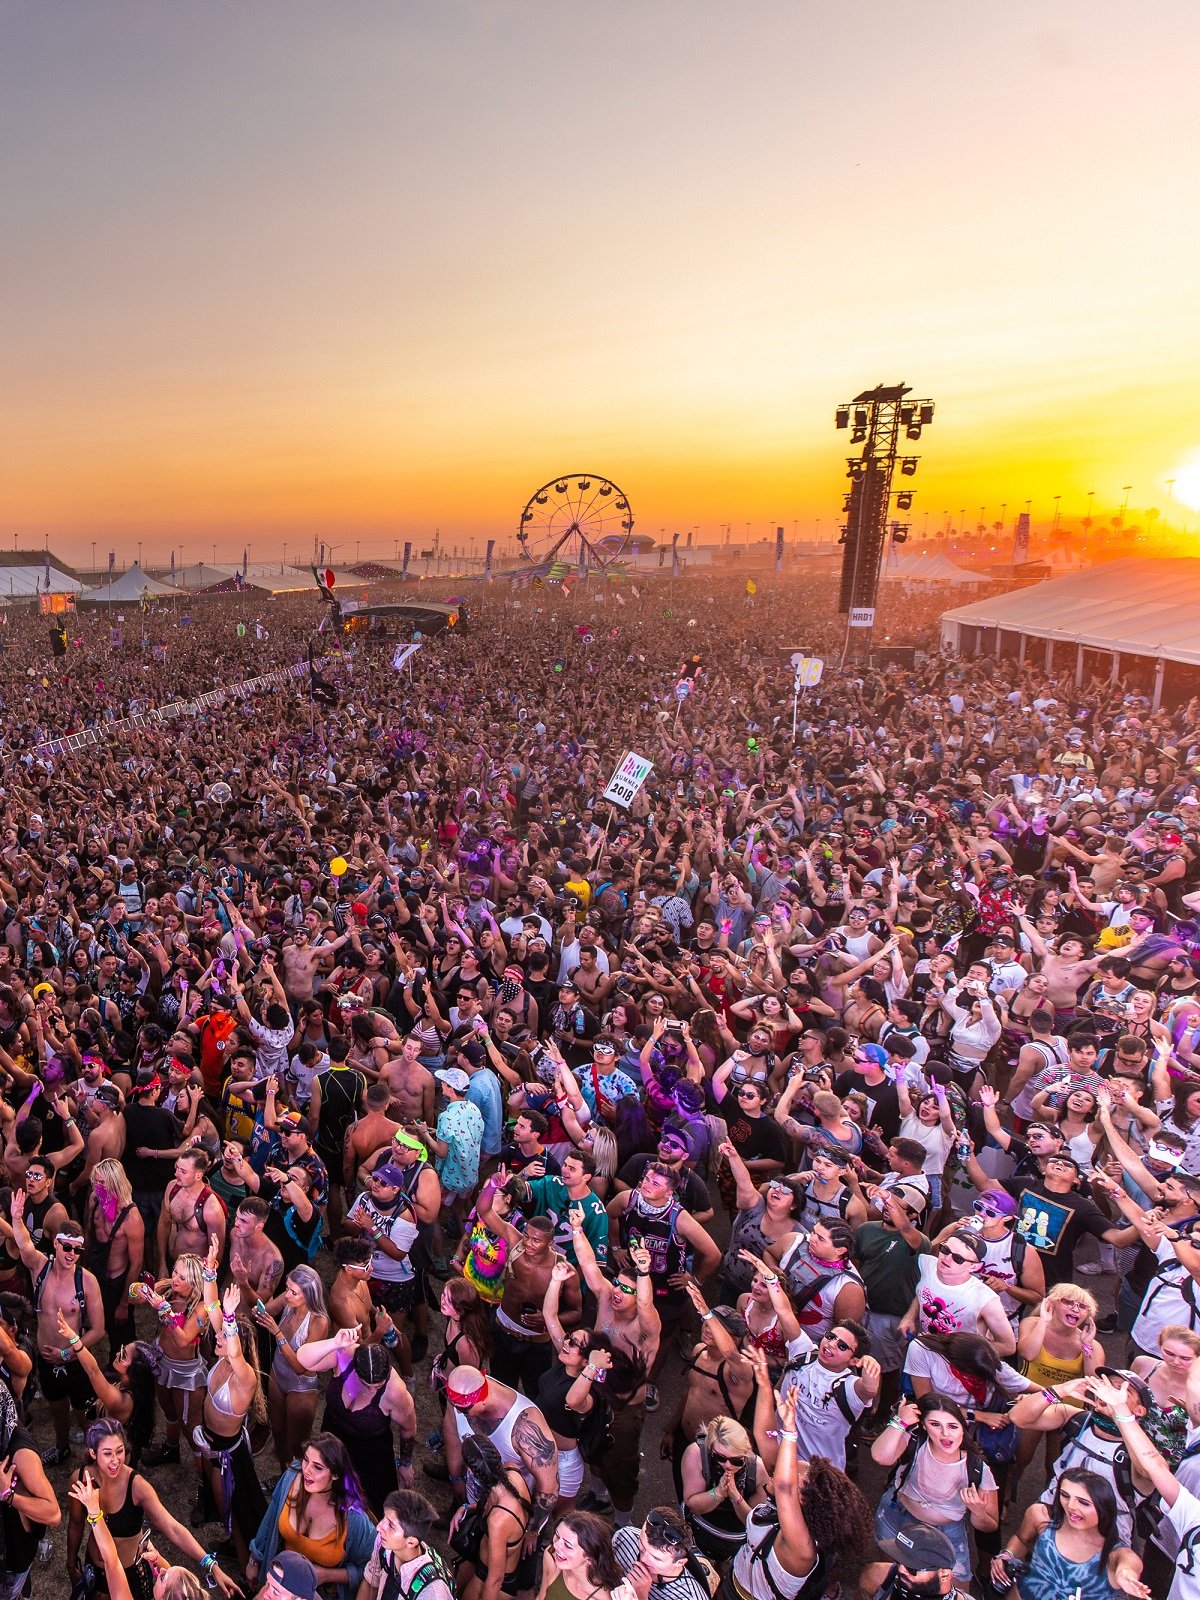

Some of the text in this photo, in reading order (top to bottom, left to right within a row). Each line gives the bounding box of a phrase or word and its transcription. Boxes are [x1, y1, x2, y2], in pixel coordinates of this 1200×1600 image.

[852, 612, 873, 621] HRD1
[614, 774, 639, 790] SUMMER
[609, 782, 634, 802] 2018
